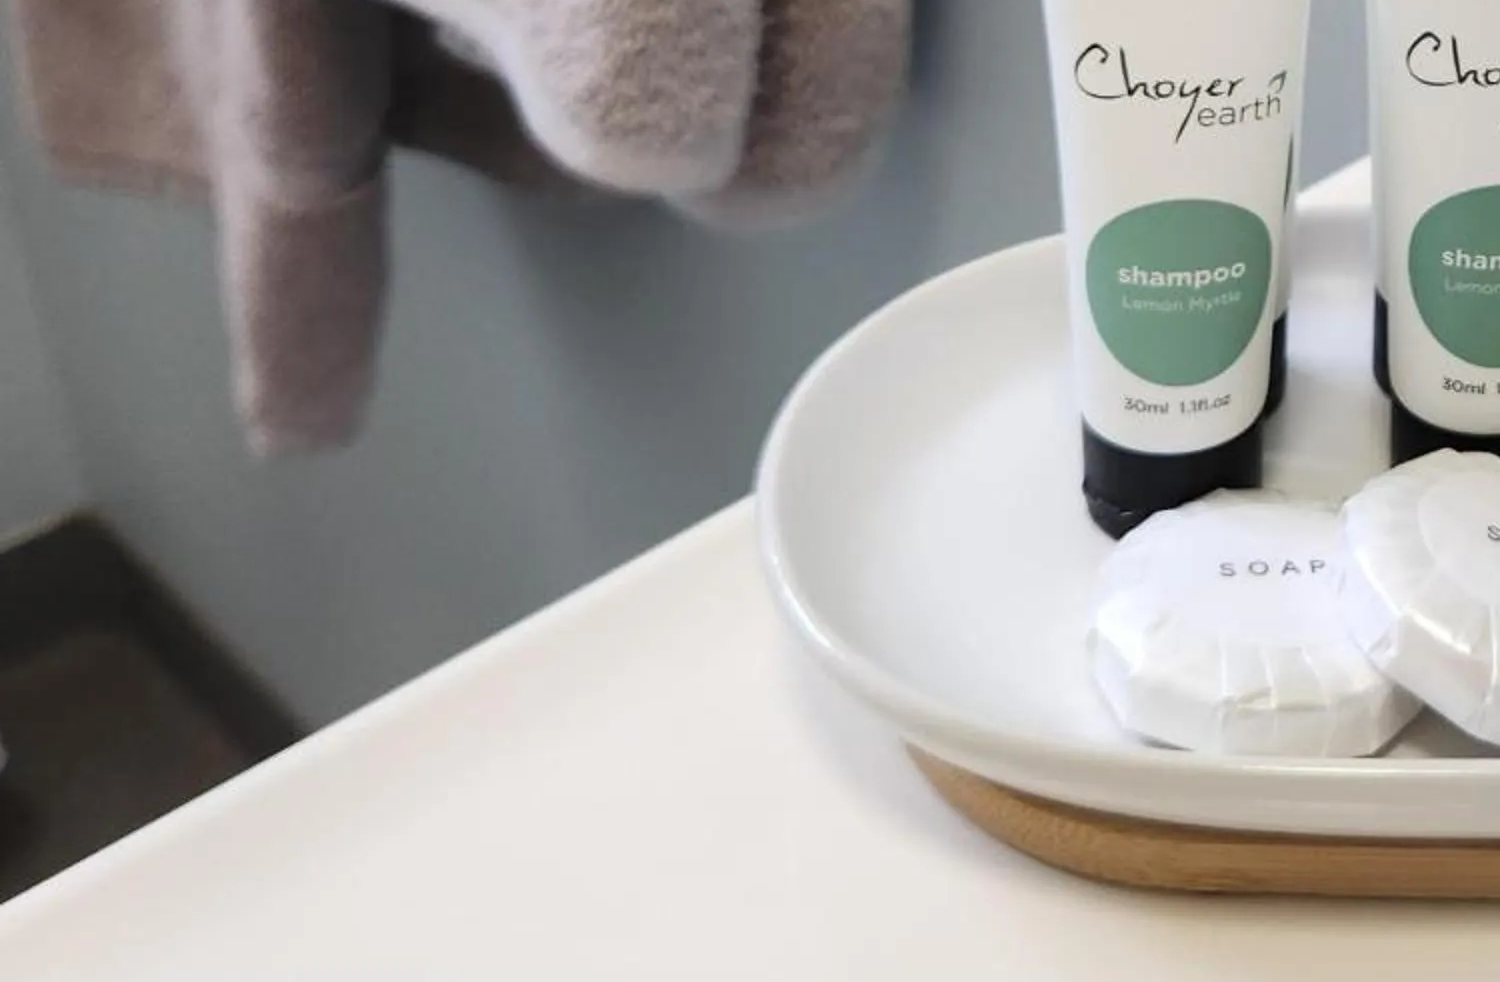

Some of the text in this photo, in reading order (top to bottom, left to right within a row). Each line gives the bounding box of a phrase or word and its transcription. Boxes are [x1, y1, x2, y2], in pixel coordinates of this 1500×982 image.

[1074, 43, 1244, 144] Choyer
[1197, 94, 1280, 127] earth
[1118, 262, 1245, 290] shampoo
[1122, 295, 1183, 312] Lemon
[1442, 377, 1485, 395] 30ml
[1124, 396, 1169, 414] 30ml
[1219, 559, 1326, 578] SOAP
